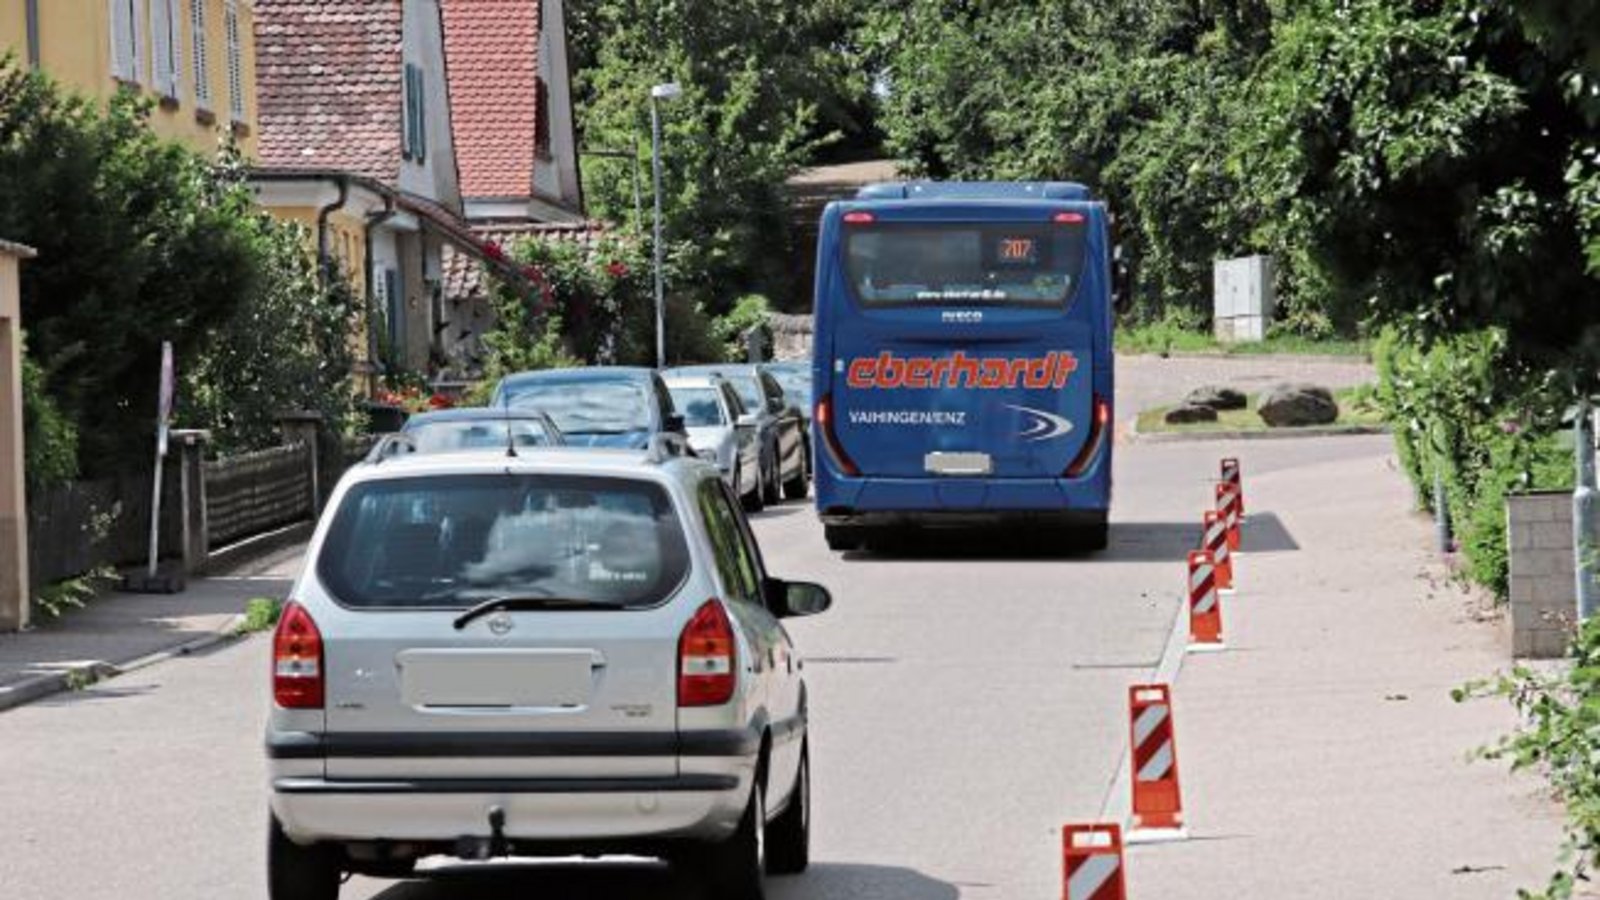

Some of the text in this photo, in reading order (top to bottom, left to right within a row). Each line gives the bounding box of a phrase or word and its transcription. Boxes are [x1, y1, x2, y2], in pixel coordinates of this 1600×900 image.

[942, 311, 982, 322] IVECO
[847, 351, 1078, 388] eberhardt
[849, 410, 966, 425] VAIHINGEN/ENZ
